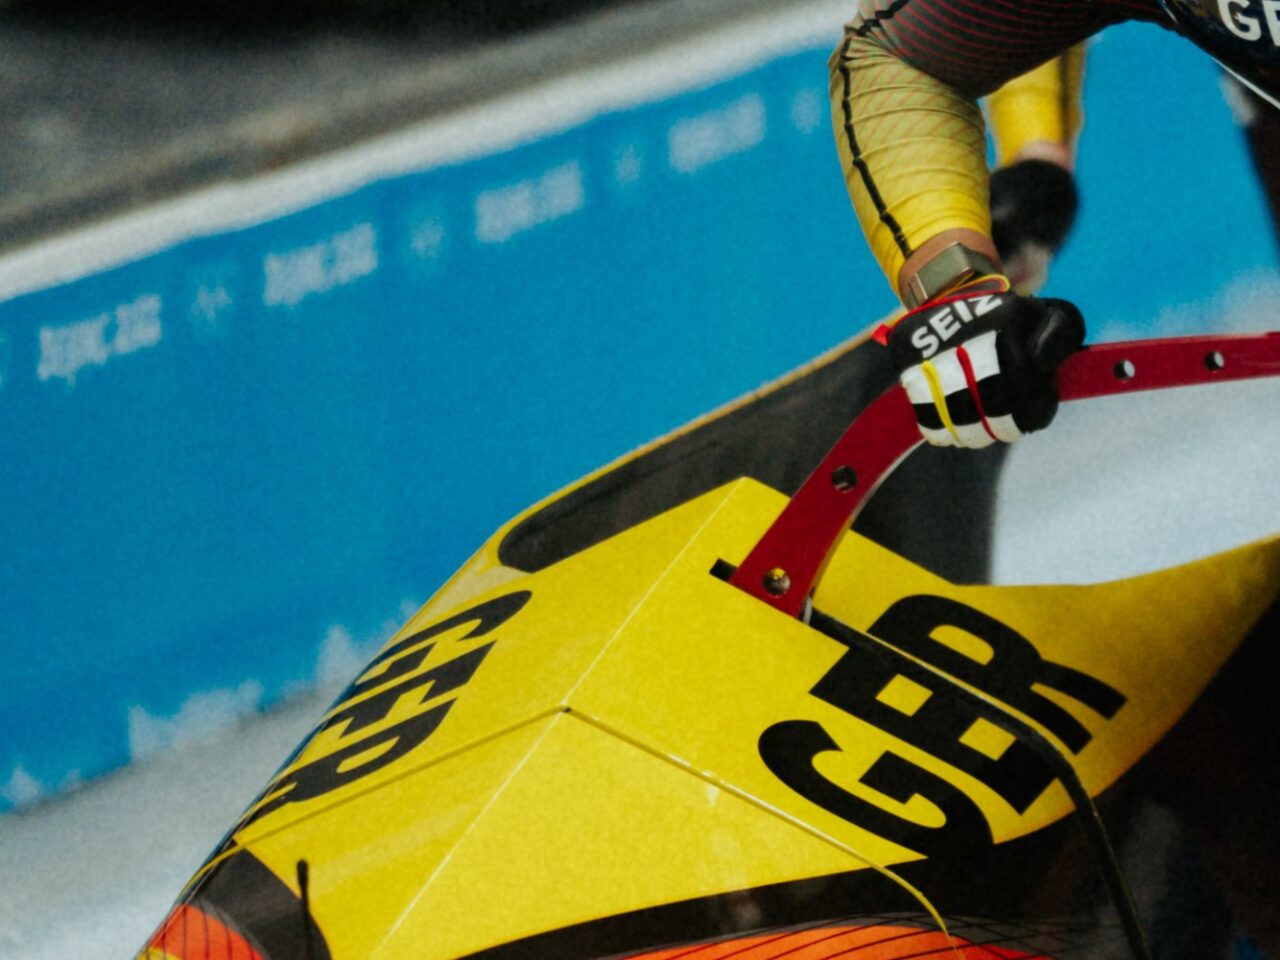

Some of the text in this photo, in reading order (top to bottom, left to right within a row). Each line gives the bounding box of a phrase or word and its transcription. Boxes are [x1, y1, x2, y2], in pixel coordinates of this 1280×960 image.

[911, 294, 1003, 359] SEIZ
[236, 590, 533, 832] GER
[757, 593, 1128, 848] GER
